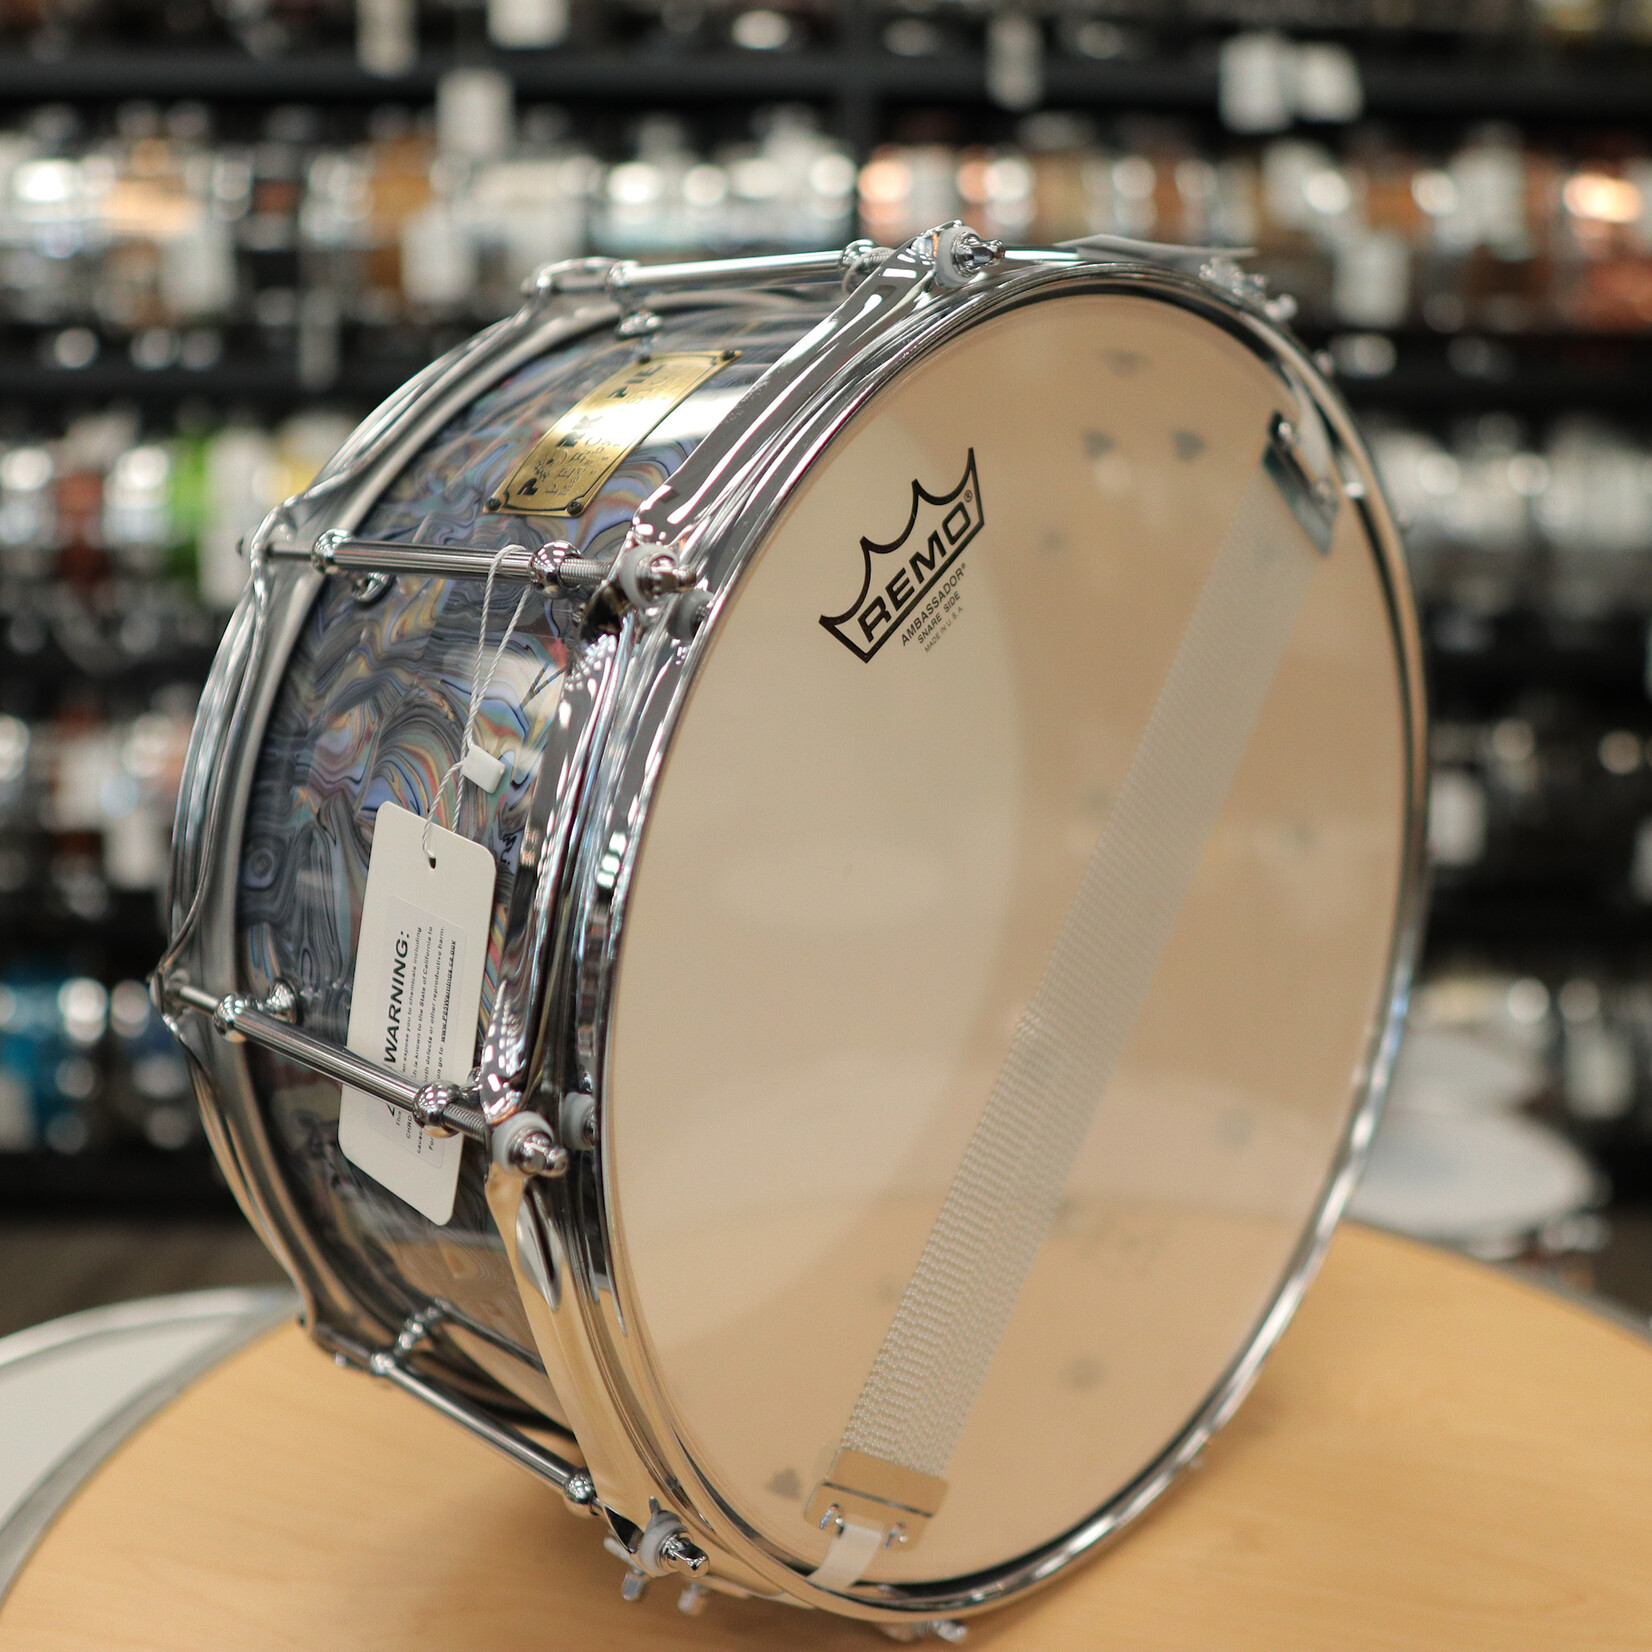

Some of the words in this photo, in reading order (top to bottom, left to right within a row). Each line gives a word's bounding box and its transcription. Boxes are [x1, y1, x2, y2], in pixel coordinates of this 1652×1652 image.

[608, 364, 666, 399] PIE
[917, 612, 942, 644] SNARE
[943, 591, 960, 613] SIDE
[924, 632, 941, 653] MADE
[940, 624, 947, 635] IN
[413, 927, 422, 964] including
[428, 926, 432, 935] to
[423, 937, 431, 974] California
[384, 930, 410, 1063] WARNING:
[408, 966, 417, 1005] chemicals
[422, 976, 427, 985] of
[429, 1025, 434, 1034] or
[432, 951, 441, 1001] reproductive
[407, 1007, 412, 1015] to
[417, 1023, 422, 1031] to
[438, 1057, 443, 1067] go
